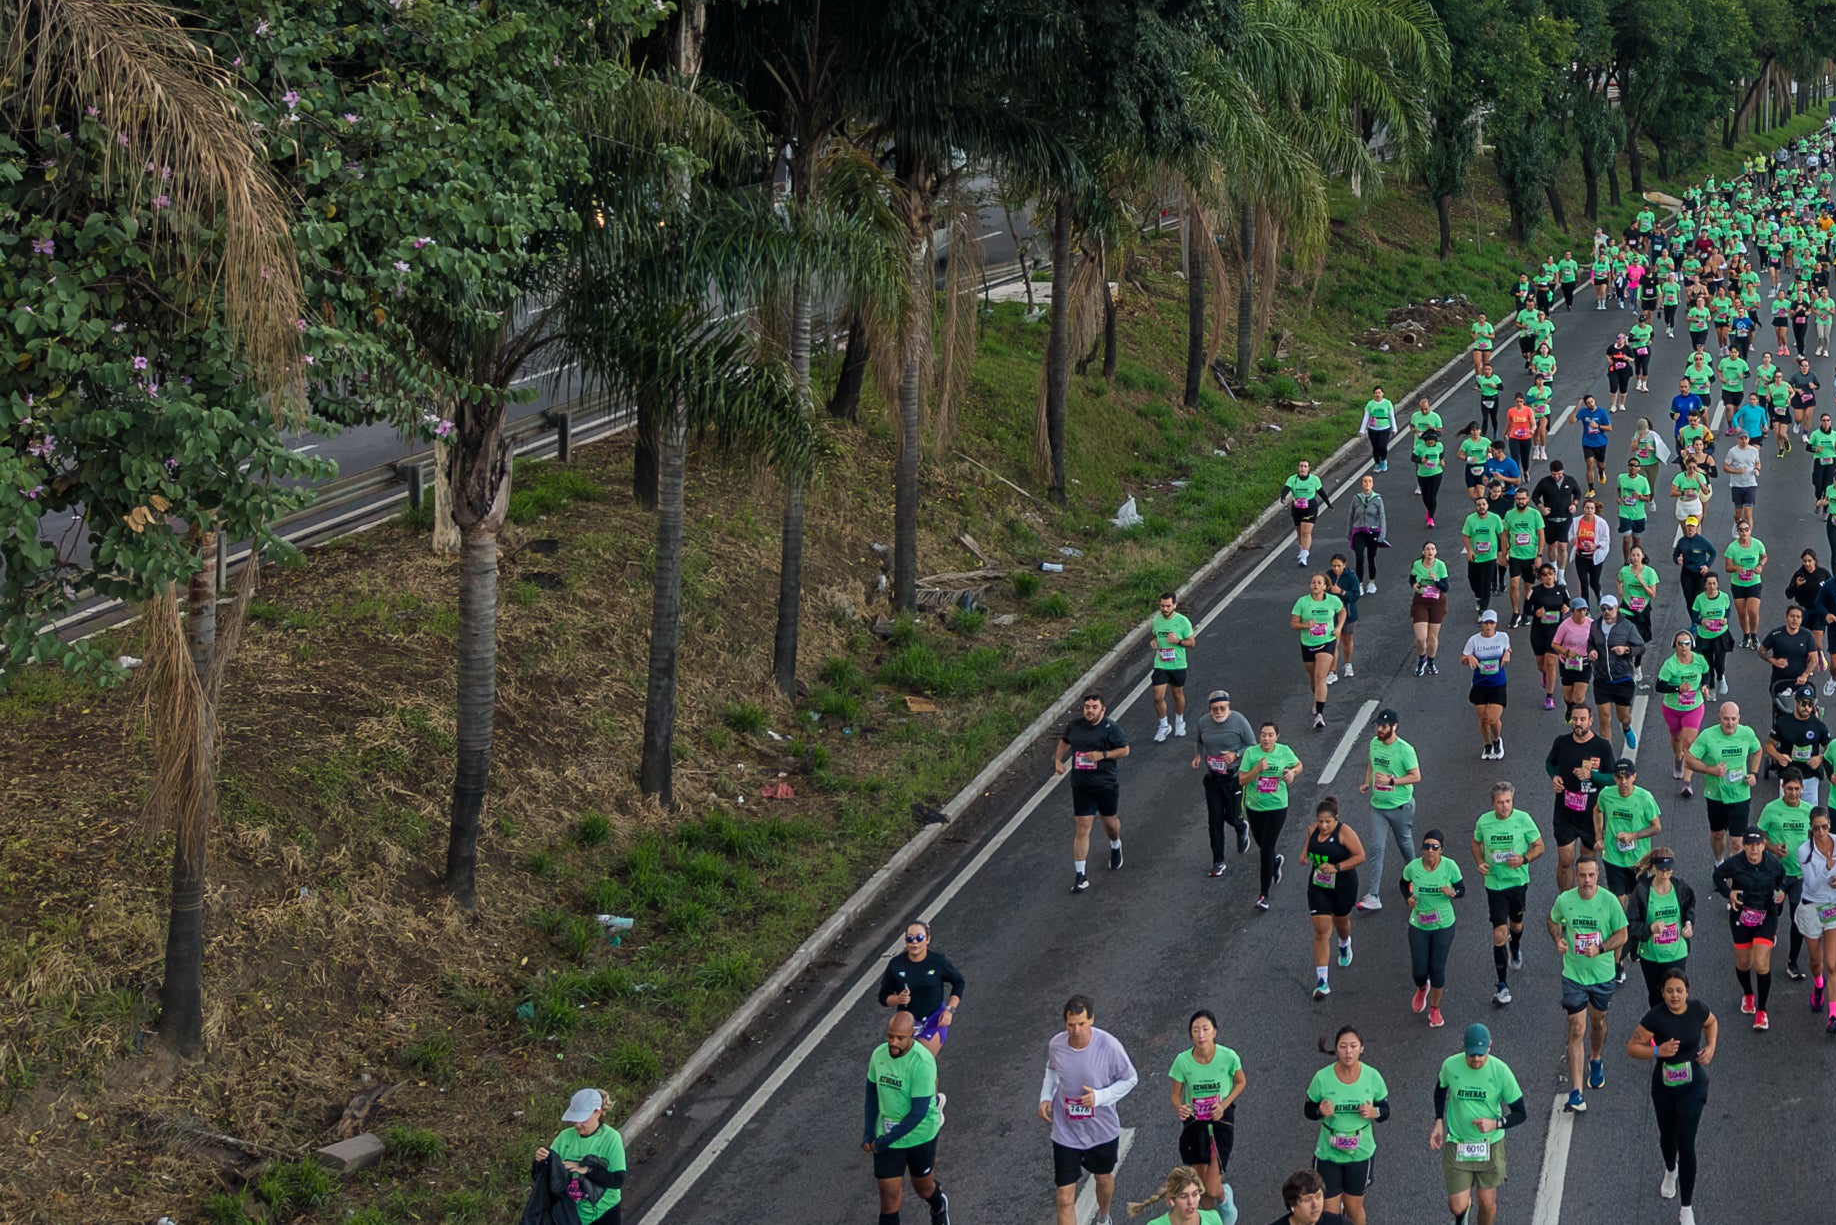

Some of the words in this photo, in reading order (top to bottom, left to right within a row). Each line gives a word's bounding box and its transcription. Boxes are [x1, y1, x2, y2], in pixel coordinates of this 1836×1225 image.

[1655, 908, 1678, 917] ATHENAS
[1572, 919, 1598, 927] ATHENAS
[1192, 1082, 1221, 1091] ATHENAS
[1456, 1089, 1487, 1099] ATHENAS
[1466, 1144, 1485, 1153] 6010
